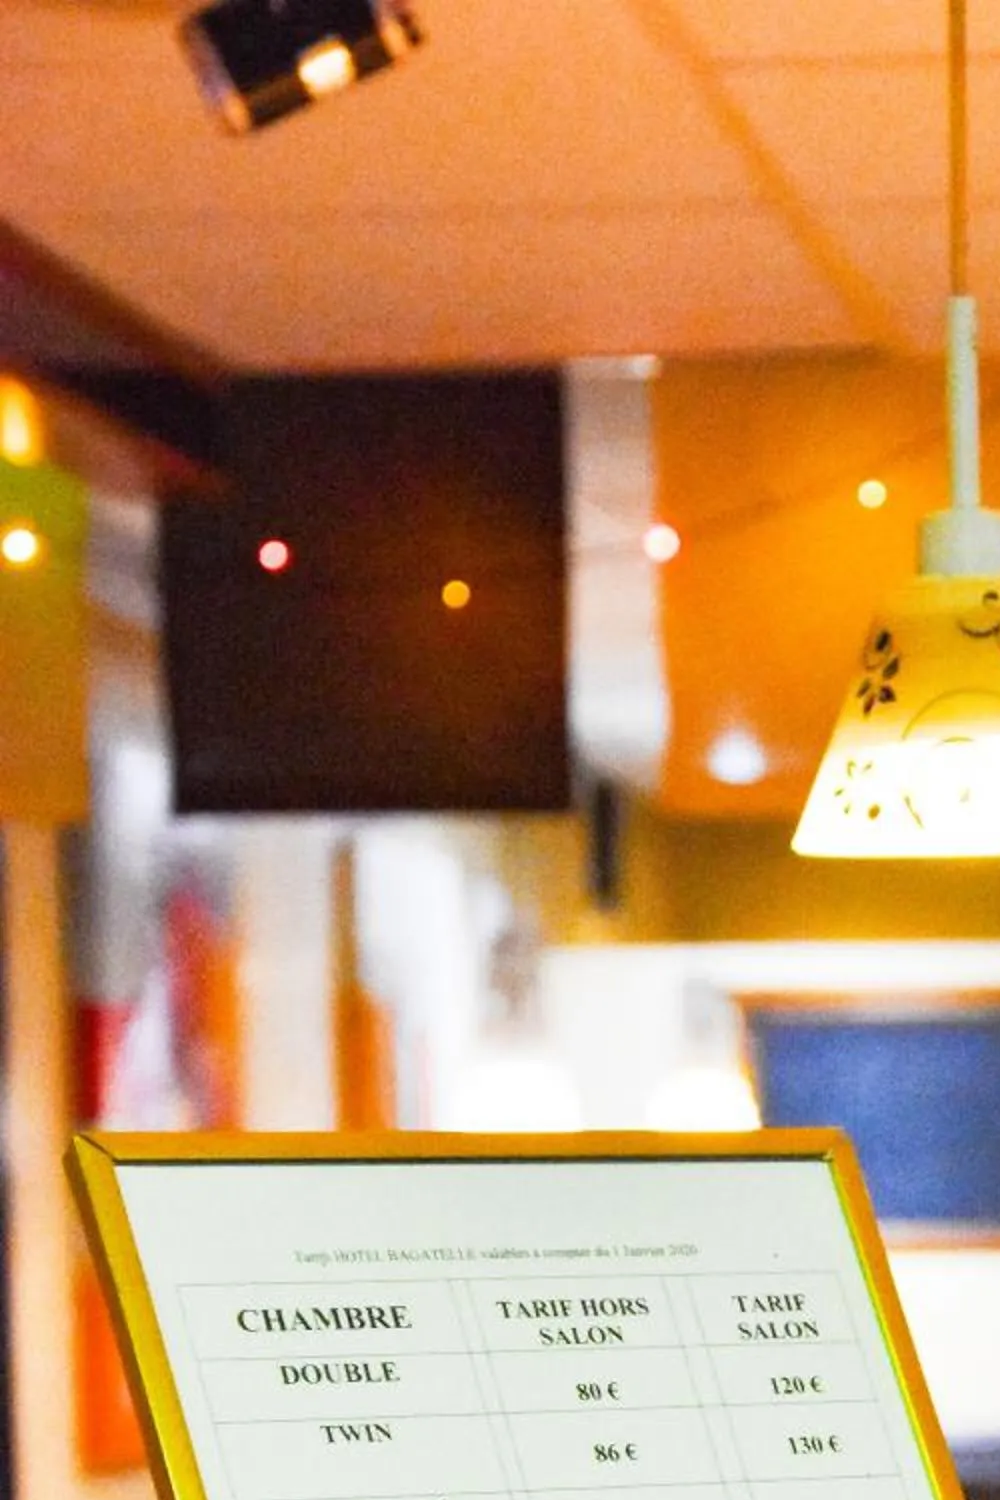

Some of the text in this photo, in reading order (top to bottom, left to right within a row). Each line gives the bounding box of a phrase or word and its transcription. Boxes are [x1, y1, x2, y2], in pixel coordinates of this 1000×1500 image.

[497, 1298, 649, 1319] TARIF HORS
[733, 1295, 805, 1313] TARIF
[237, 1306, 412, 1332] CHAMBRE
[540, 1327, 624, 1345] SALON
[738, 1322, 819, 1339] SALON
[280, 1362, 400, 1384] DOUBLE
[576, 1382, 620, 1400] 80 €
[771, 1376, 823, 1394] 120 €
[321, 1424, 392, 1443] TWIN
[593, 1443, 638, 1461] 86 €
[789, 1436, 842, 1454] 130 €
